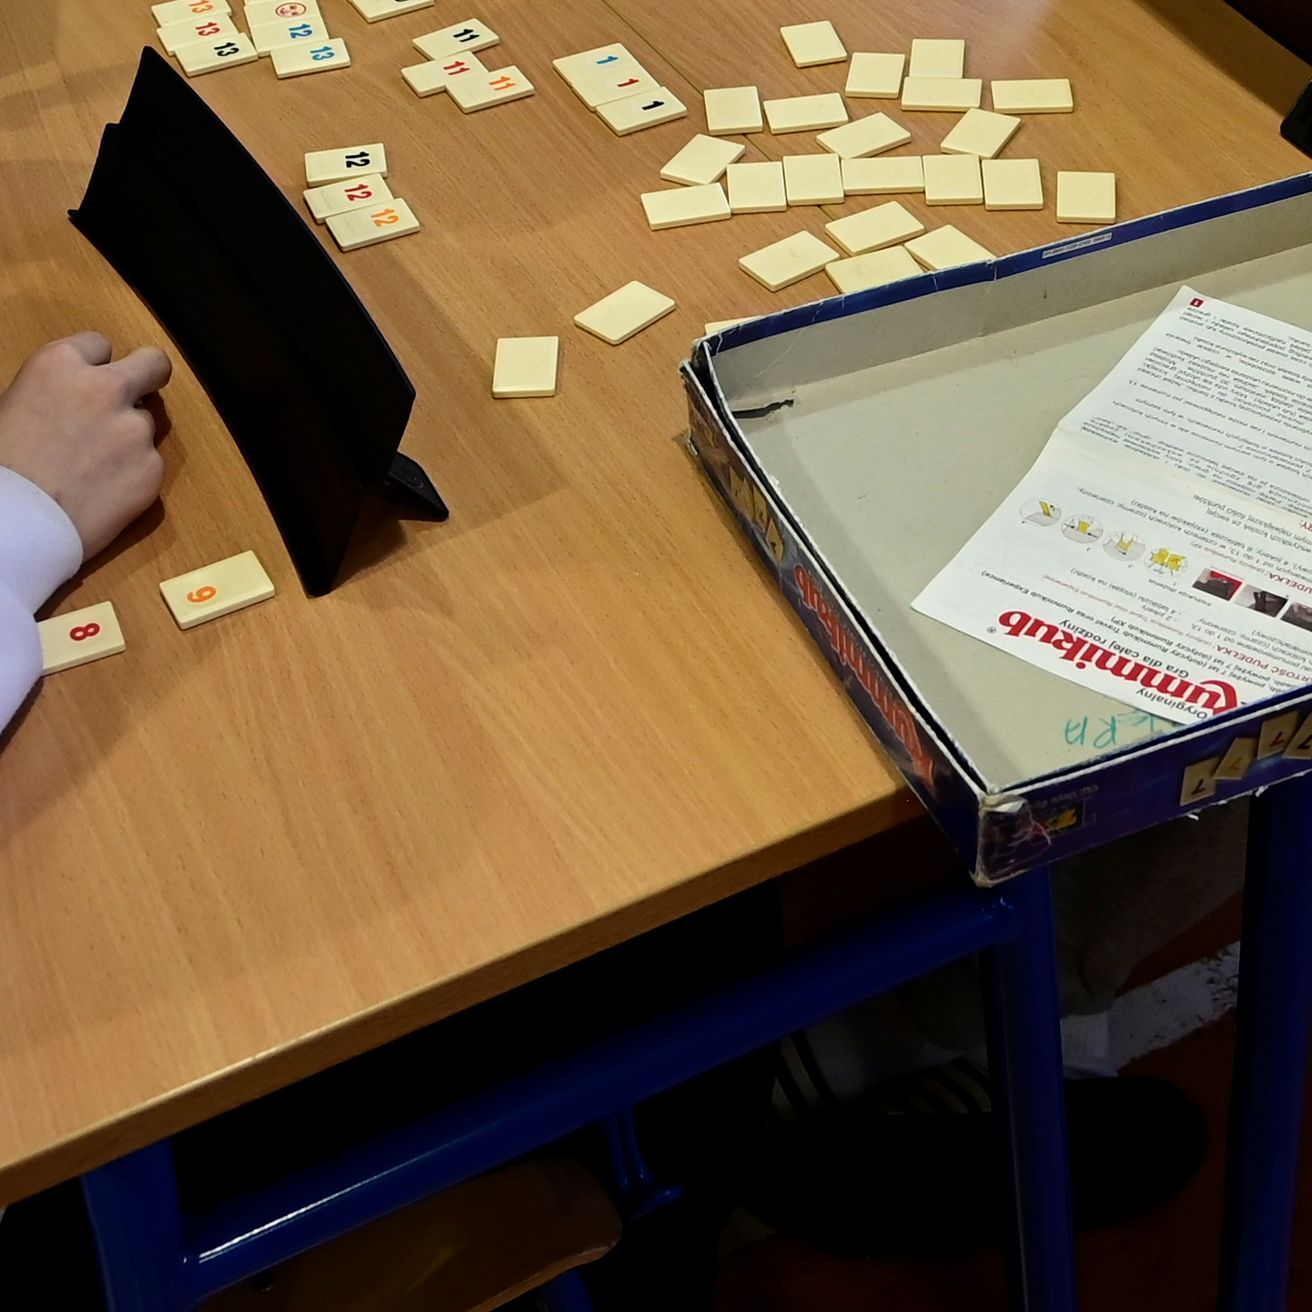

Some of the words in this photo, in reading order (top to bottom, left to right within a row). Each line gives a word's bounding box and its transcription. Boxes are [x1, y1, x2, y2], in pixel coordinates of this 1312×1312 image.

[188, 0, 214, 14] 13
[195, 21, 221, 37] 13
[288, 23, 313, 39] 12
[453, 28, 480, 43] 11
[213, 42, 240, 57] 13
[309, 45, 336, 61] 13
[443, 60, 471, 76] 11
[596, 55, 619, 65] 1
[488, 75, 516, 91] 11
[616, 78, 640, 88] 1
[642, 100, 665, 111] 1
[345, 151, 371, 168] 12
[344, 183, 373, 202] 12
[370, 208, 401, 228] 12
[186, 585, 217, 603] 6
[69, 622, 101, 642] 8
[1057, 618, 1108, 645] rodziny
[1107, 640, 1140, 659] całej
[1140, 654, 1162, 669] dla
[1165, 664, 1190, 676] Gra
[1134, 686, 1209, 720] Oryginalny
